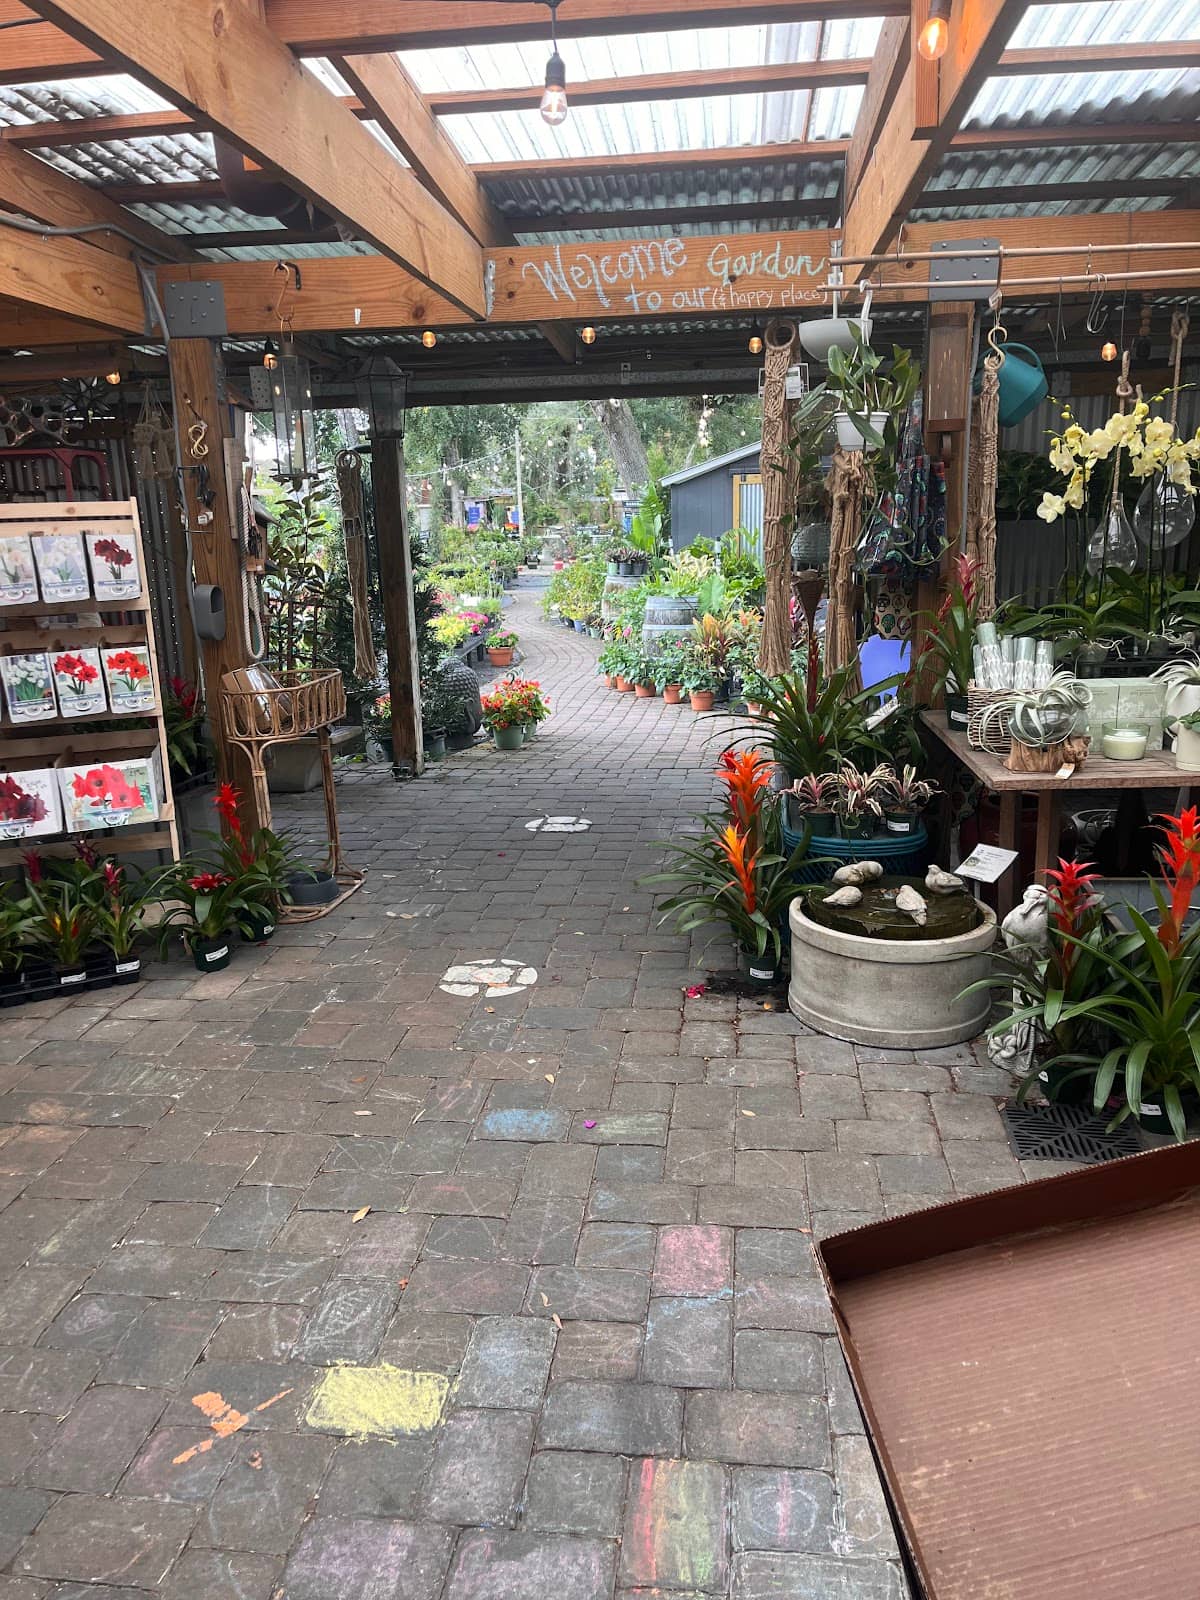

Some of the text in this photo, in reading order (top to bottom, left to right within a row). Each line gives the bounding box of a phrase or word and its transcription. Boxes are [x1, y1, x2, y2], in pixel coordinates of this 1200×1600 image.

[522, 238, 827, 308] Welcome Garden
[624, 283, 710, 312] to our
[729, 284, 774, 308] happy
